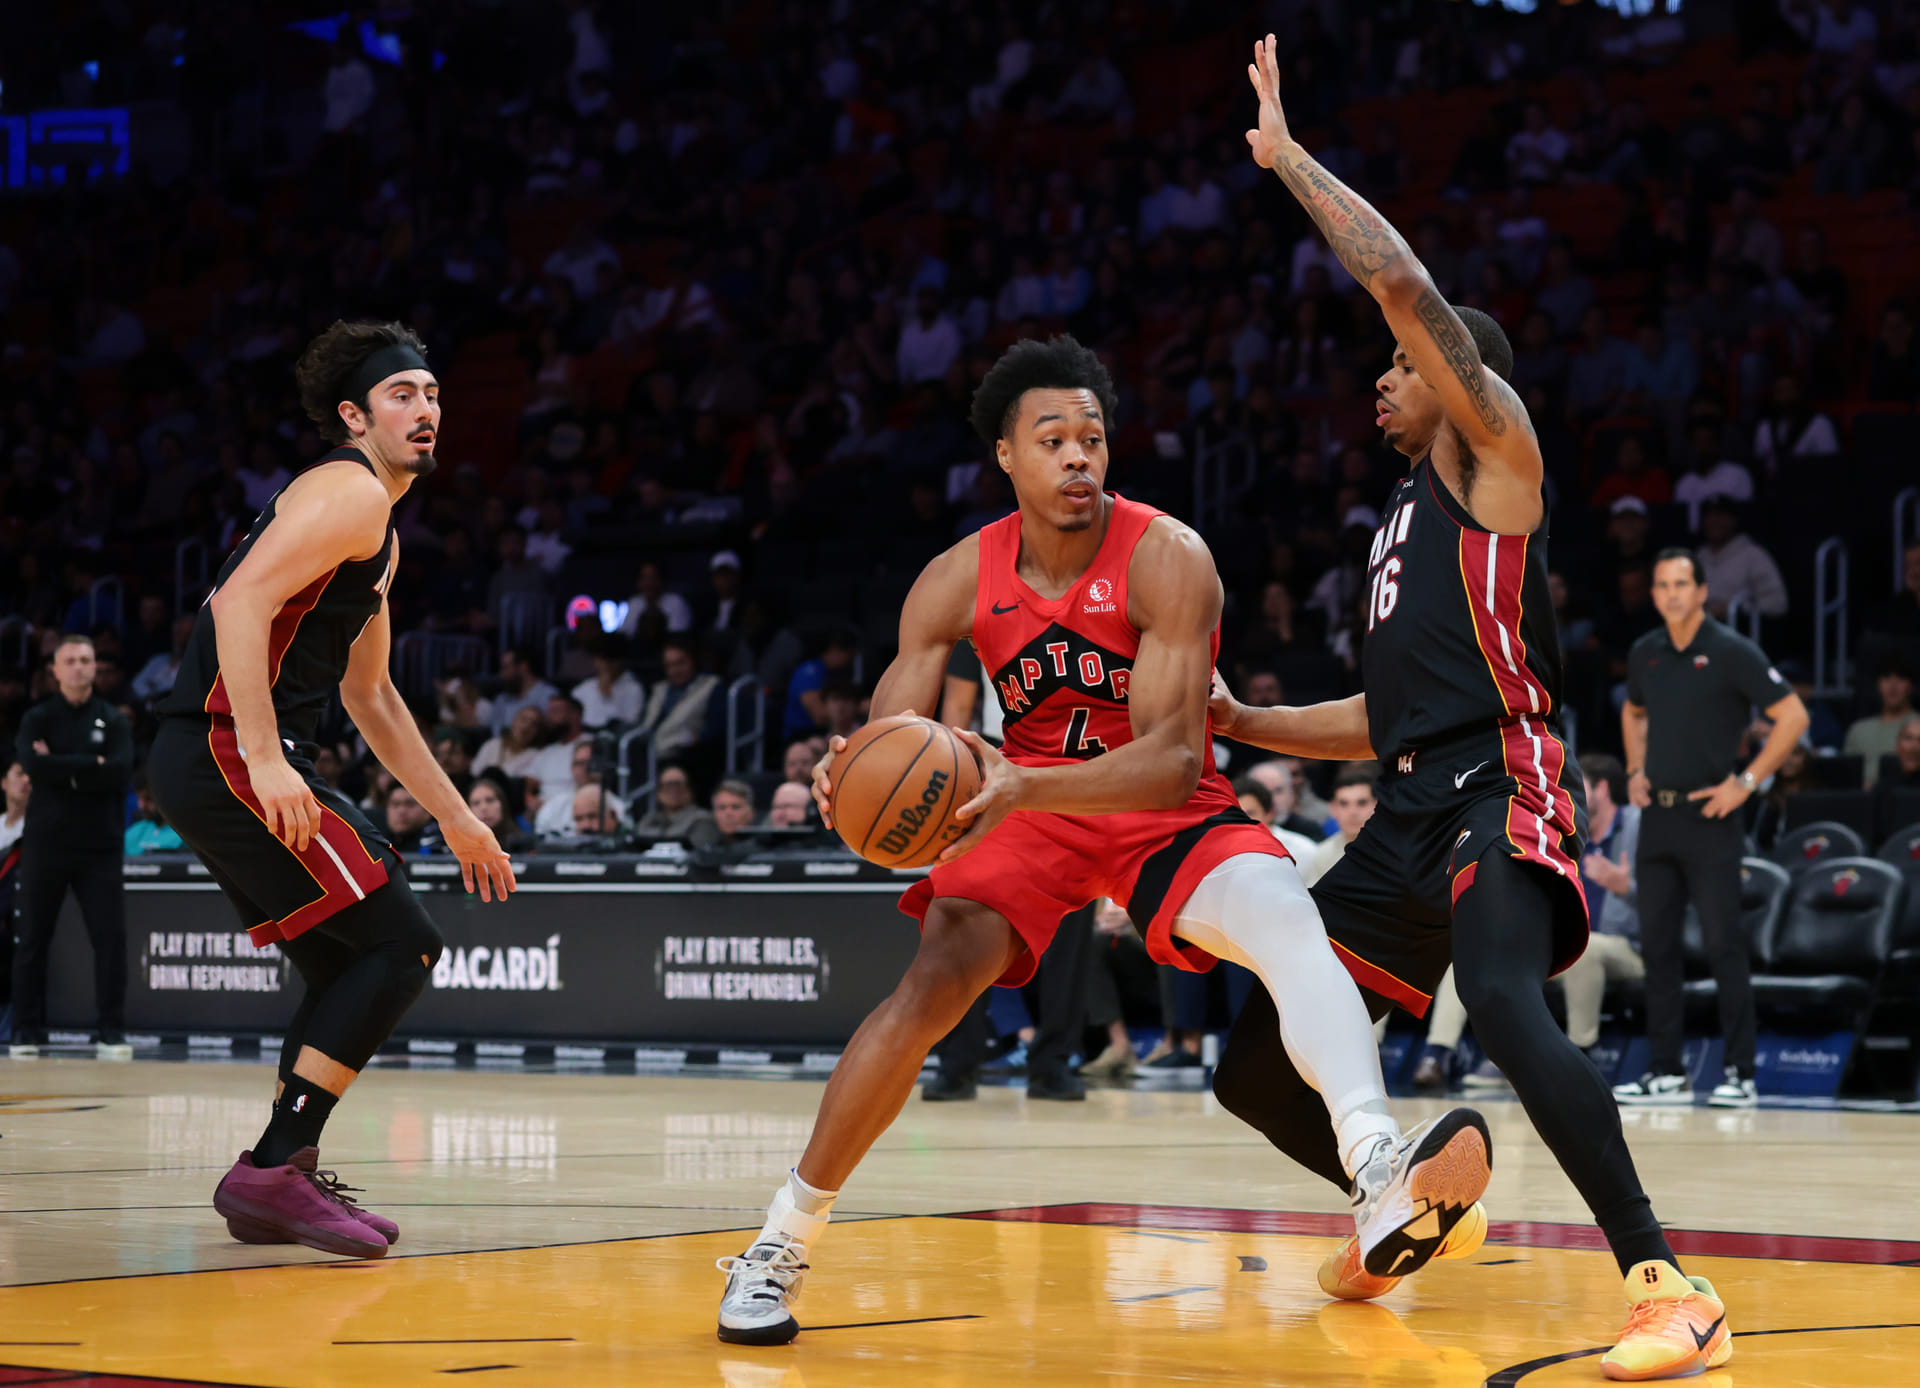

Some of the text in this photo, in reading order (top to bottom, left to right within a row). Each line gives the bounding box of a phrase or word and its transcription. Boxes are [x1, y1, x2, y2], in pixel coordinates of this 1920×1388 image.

[1308, 171, 1335, 195] bigger
[1333, 195, 1353, 216] than
[1312, 190, 1348, 228] FEAR
[1083, 601, 1117, 614] Sun Life
[1368, 554, 1403, 634] 16
[999, 640, 1133, 713] RAPTOR
[1062, 707, 1108, 761] 4
[876, 769, 949, 855] Wilson
[149, 931, 184, 958] PLAY
[184, 931, 205, 958] BY
[205, 931, 233, 959] THE
[664, 936, 705, 964] PLAY
[706, 936, 728, 965] BY
[728, 936, 762, 965] THE
[149, 964, 190, 991] DRINK
[664, 971, 713, 1000] DRINK
